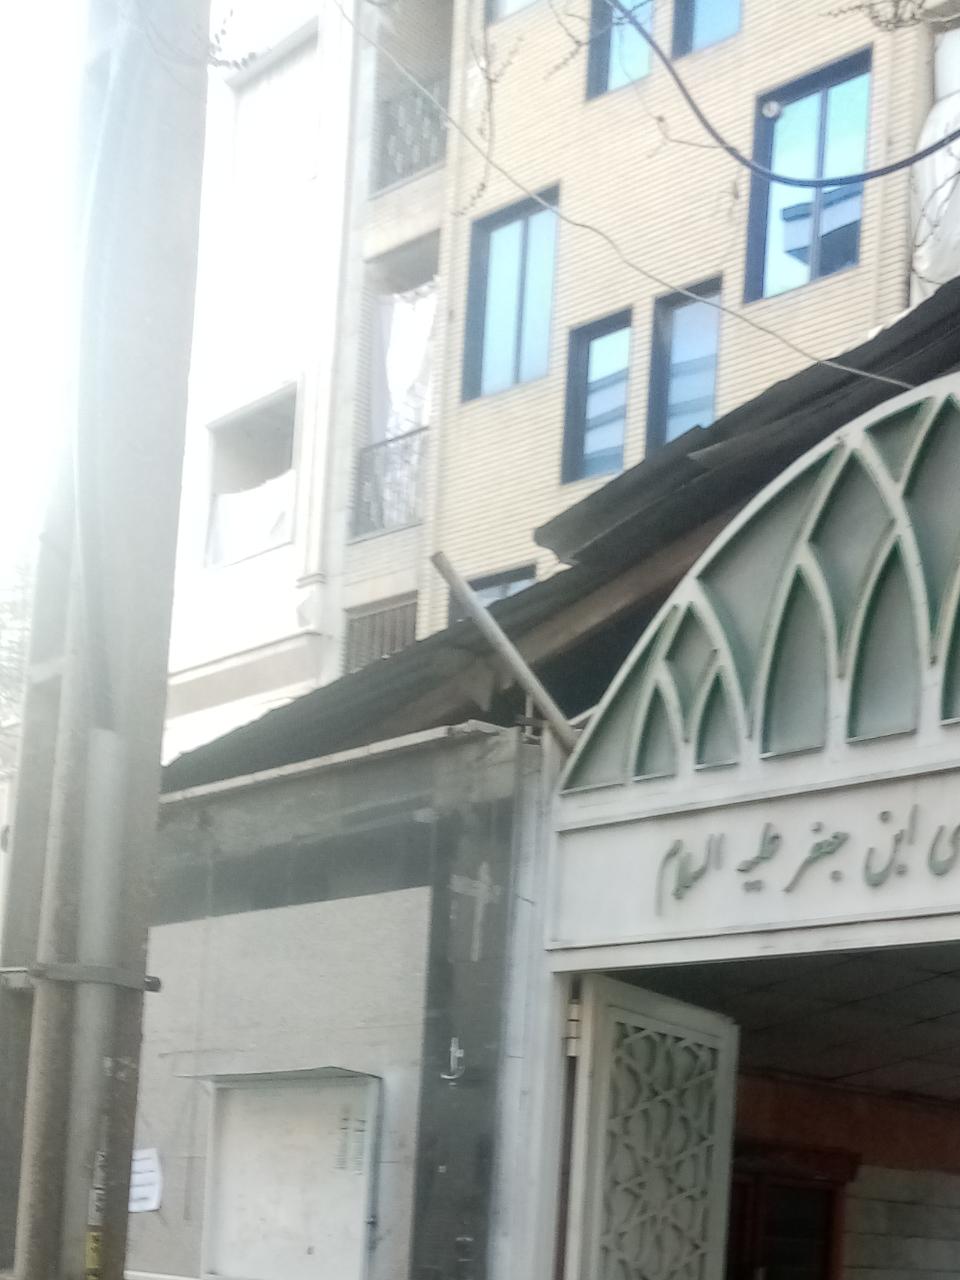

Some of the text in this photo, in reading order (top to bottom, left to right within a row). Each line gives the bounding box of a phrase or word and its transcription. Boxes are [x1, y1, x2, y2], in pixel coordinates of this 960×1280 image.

[653, 832, 725, 917] السلام
[736, 822, 782, 892] علیه
[782, 821, 849, 893] جعفر
[864, 803, 920, 887] ابن
